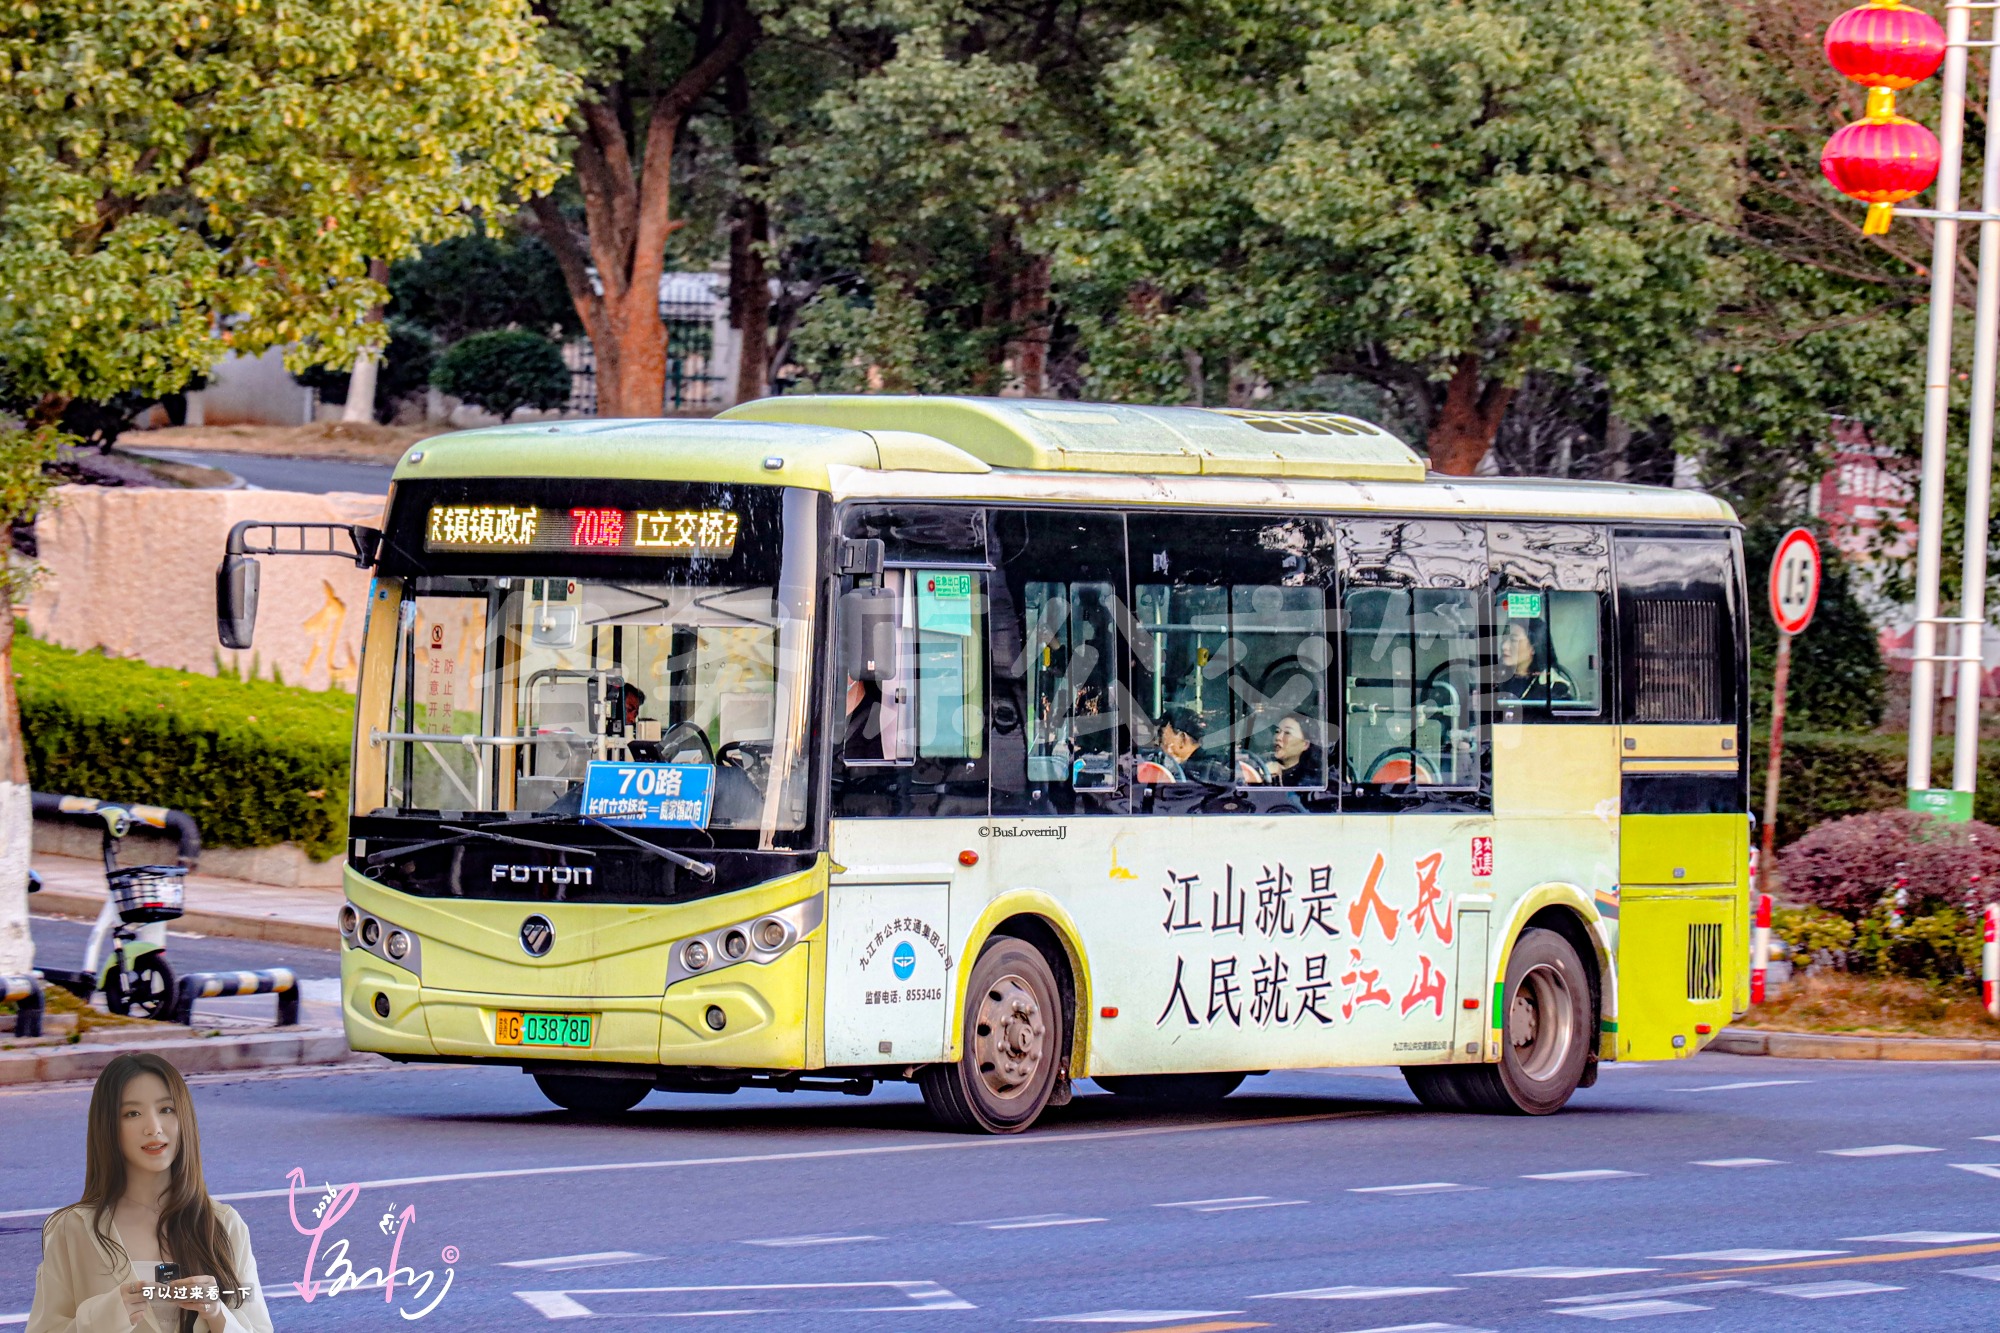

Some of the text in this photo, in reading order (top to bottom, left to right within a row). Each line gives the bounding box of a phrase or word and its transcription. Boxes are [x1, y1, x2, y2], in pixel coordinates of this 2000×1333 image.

[571, 510, 624, 546] 70路
[1784, 558, 1808, 604] 15
[618, 768, 682, 796] 70路
[492, 865, 593, 885] FOTON
[1162, 851, 1454, 944] 江山就是人民
[860, 917, 953, 972] 九江市公共交通集团公司
[1156, 949, 1447, 1027] 人民就是江山
